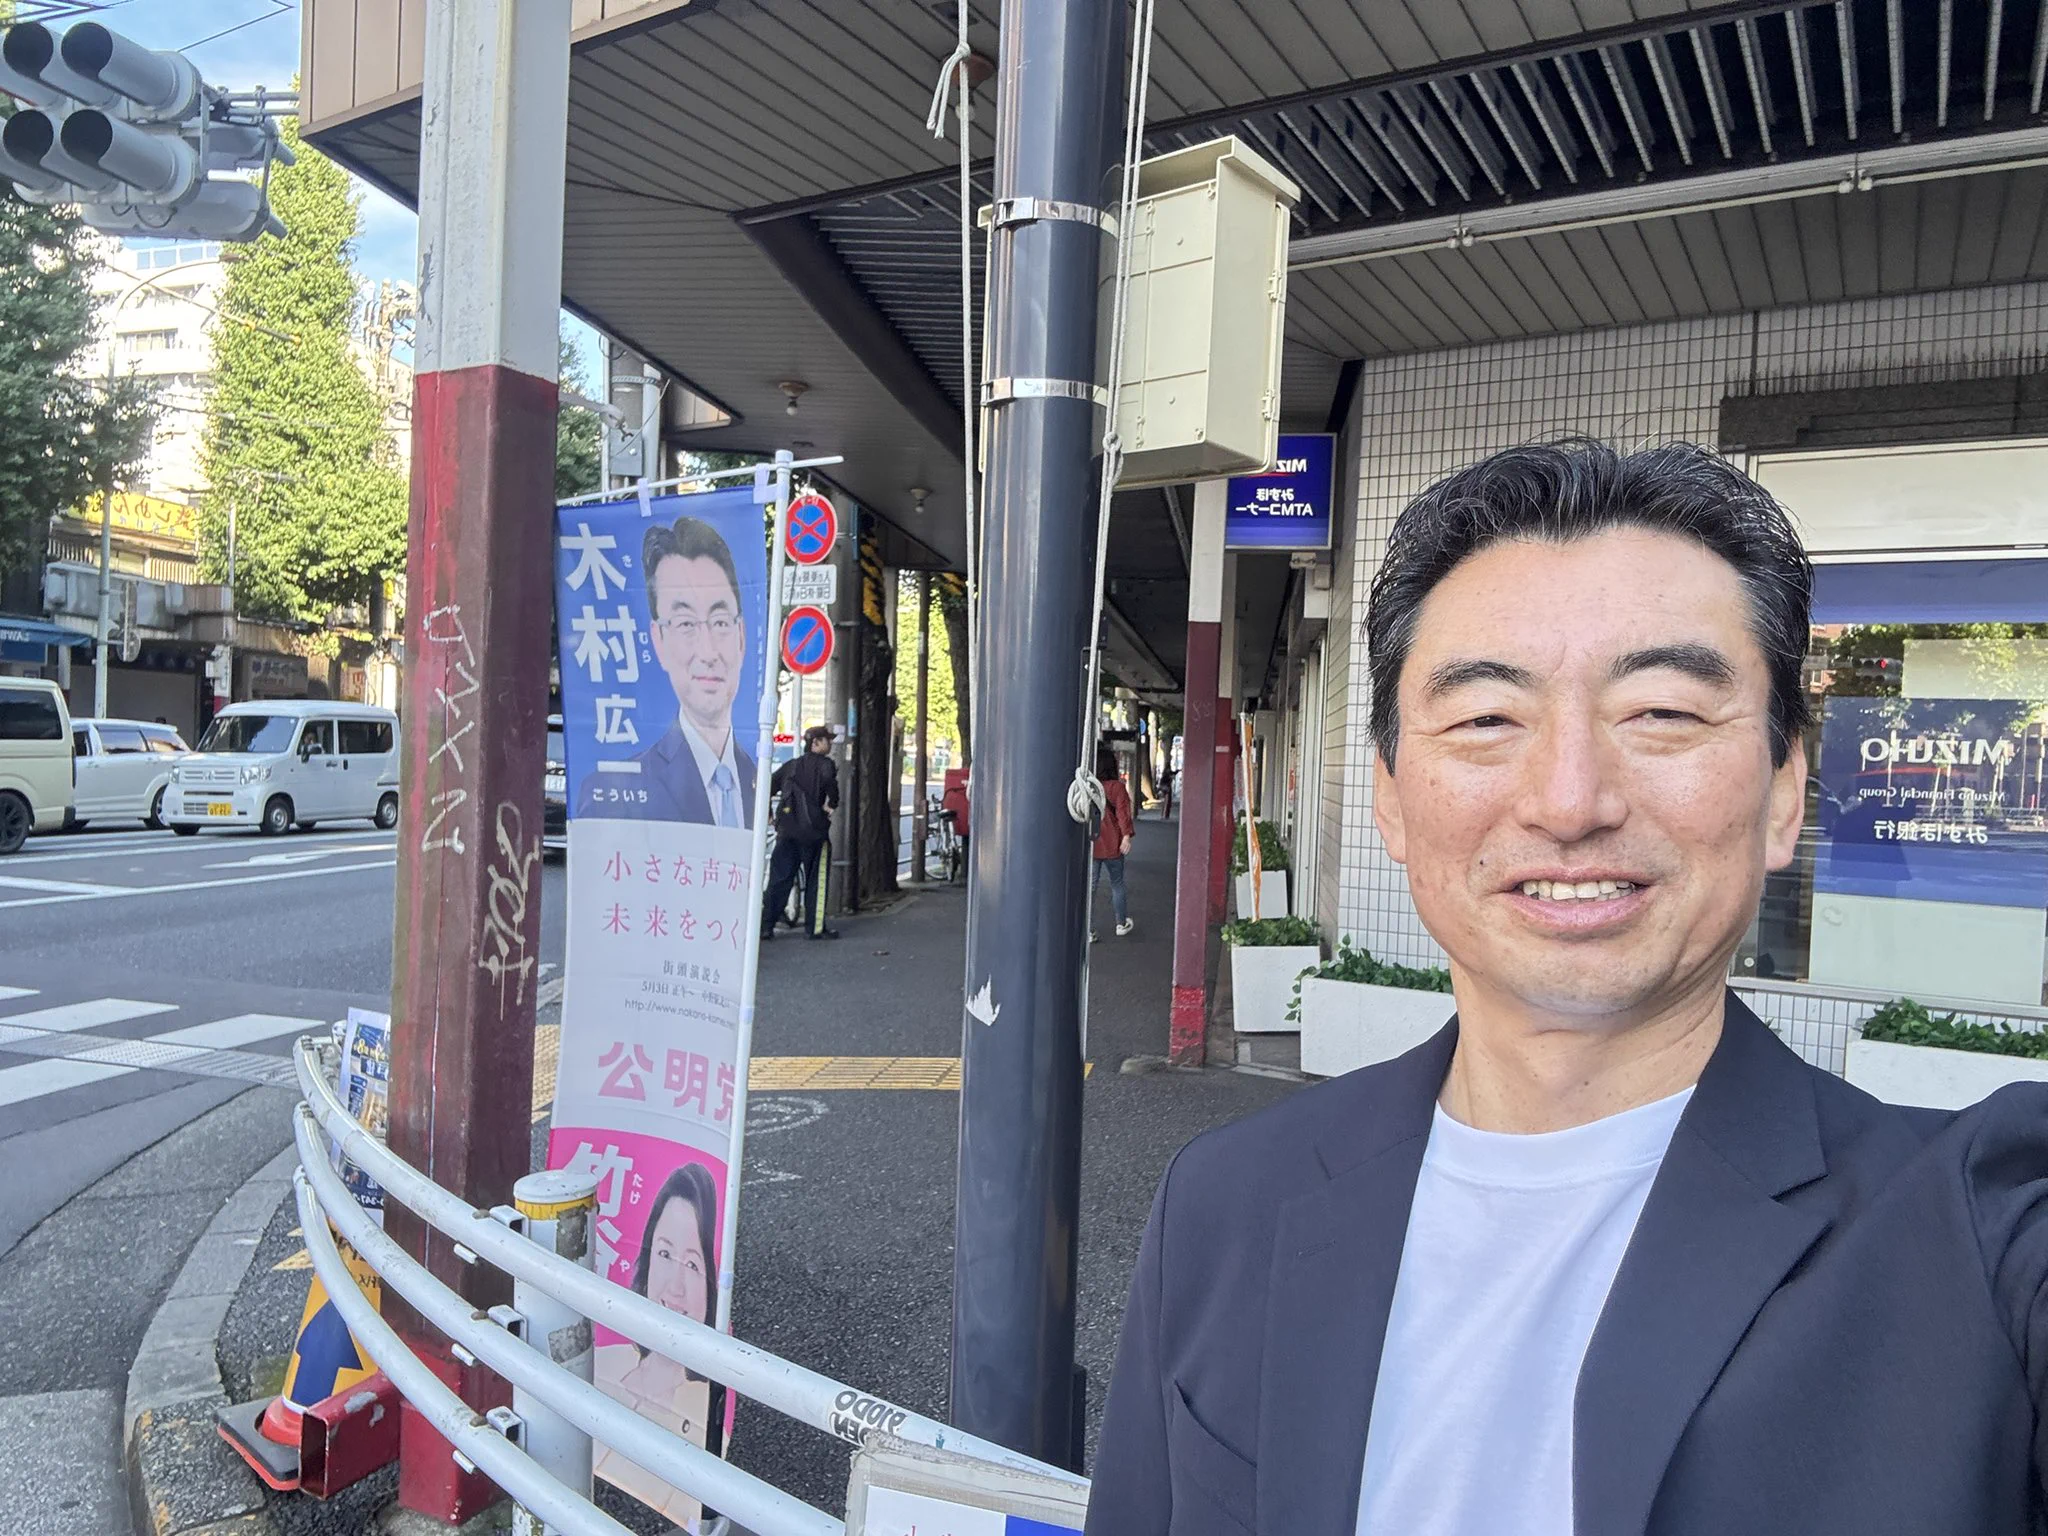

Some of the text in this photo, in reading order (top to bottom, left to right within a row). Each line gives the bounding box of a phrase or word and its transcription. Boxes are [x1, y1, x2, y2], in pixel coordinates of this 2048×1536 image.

[560, 523, 642, 774] 木村広一
[637, 631, 652, 664] むら
[593, 788, 649, 803] こういち
[603, 850, 751, 892] 小さな声か
[602, 902, 747, 951] 未来をつく
[632, 1172, 644, 1205] たけ
